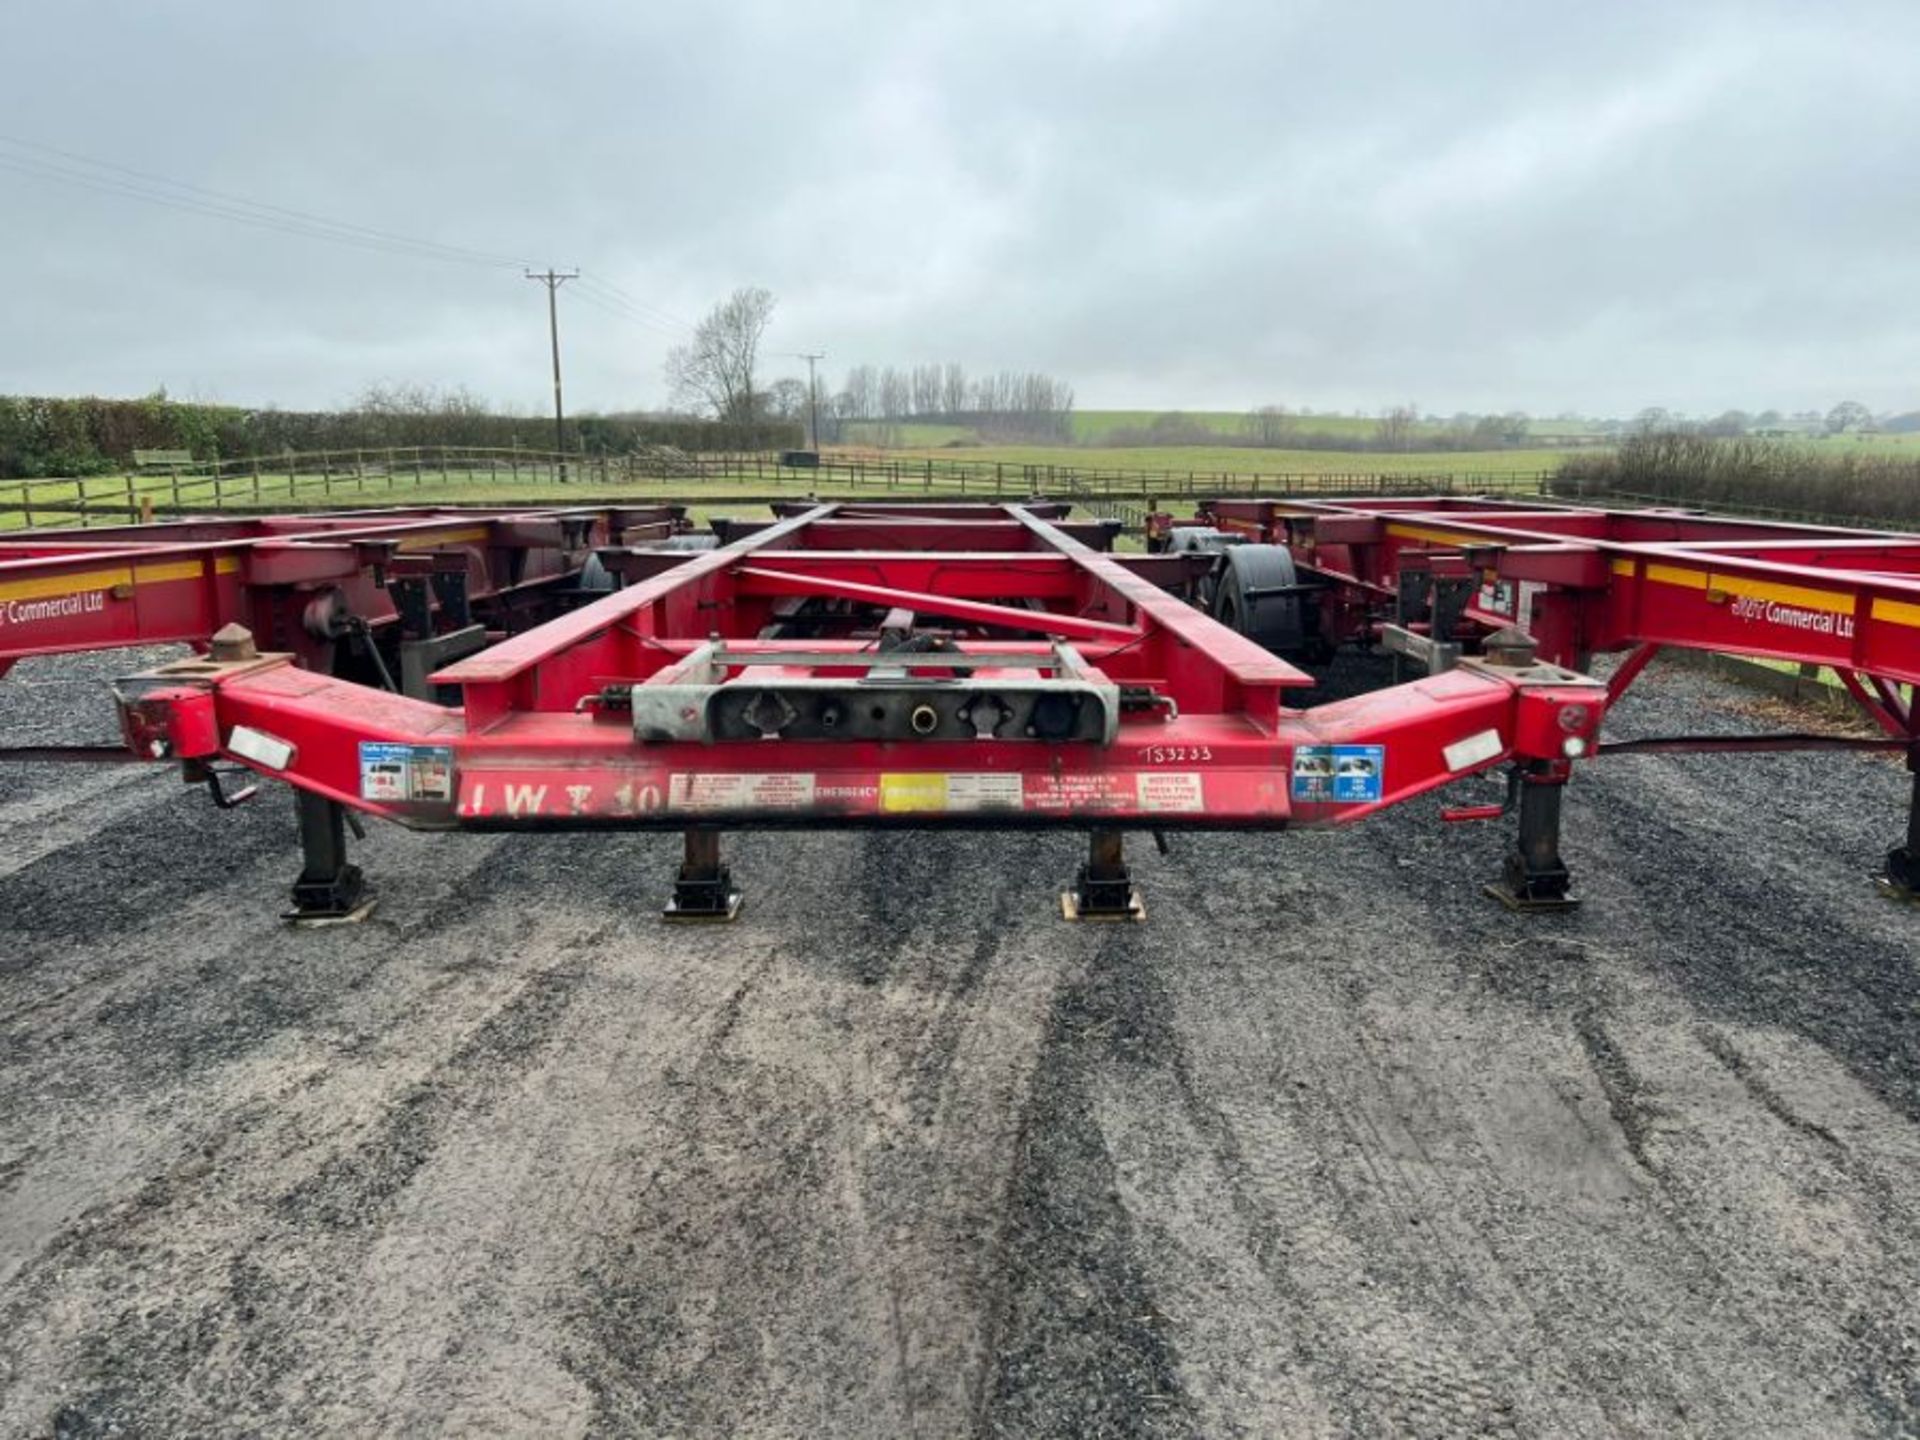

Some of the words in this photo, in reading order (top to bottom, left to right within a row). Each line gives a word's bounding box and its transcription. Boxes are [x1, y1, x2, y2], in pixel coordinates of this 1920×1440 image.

[8, 593, 82, 623] Commercial
[85, 591, 103, 612] Ltd
[1766, 600, 1834, 633] Commercial
